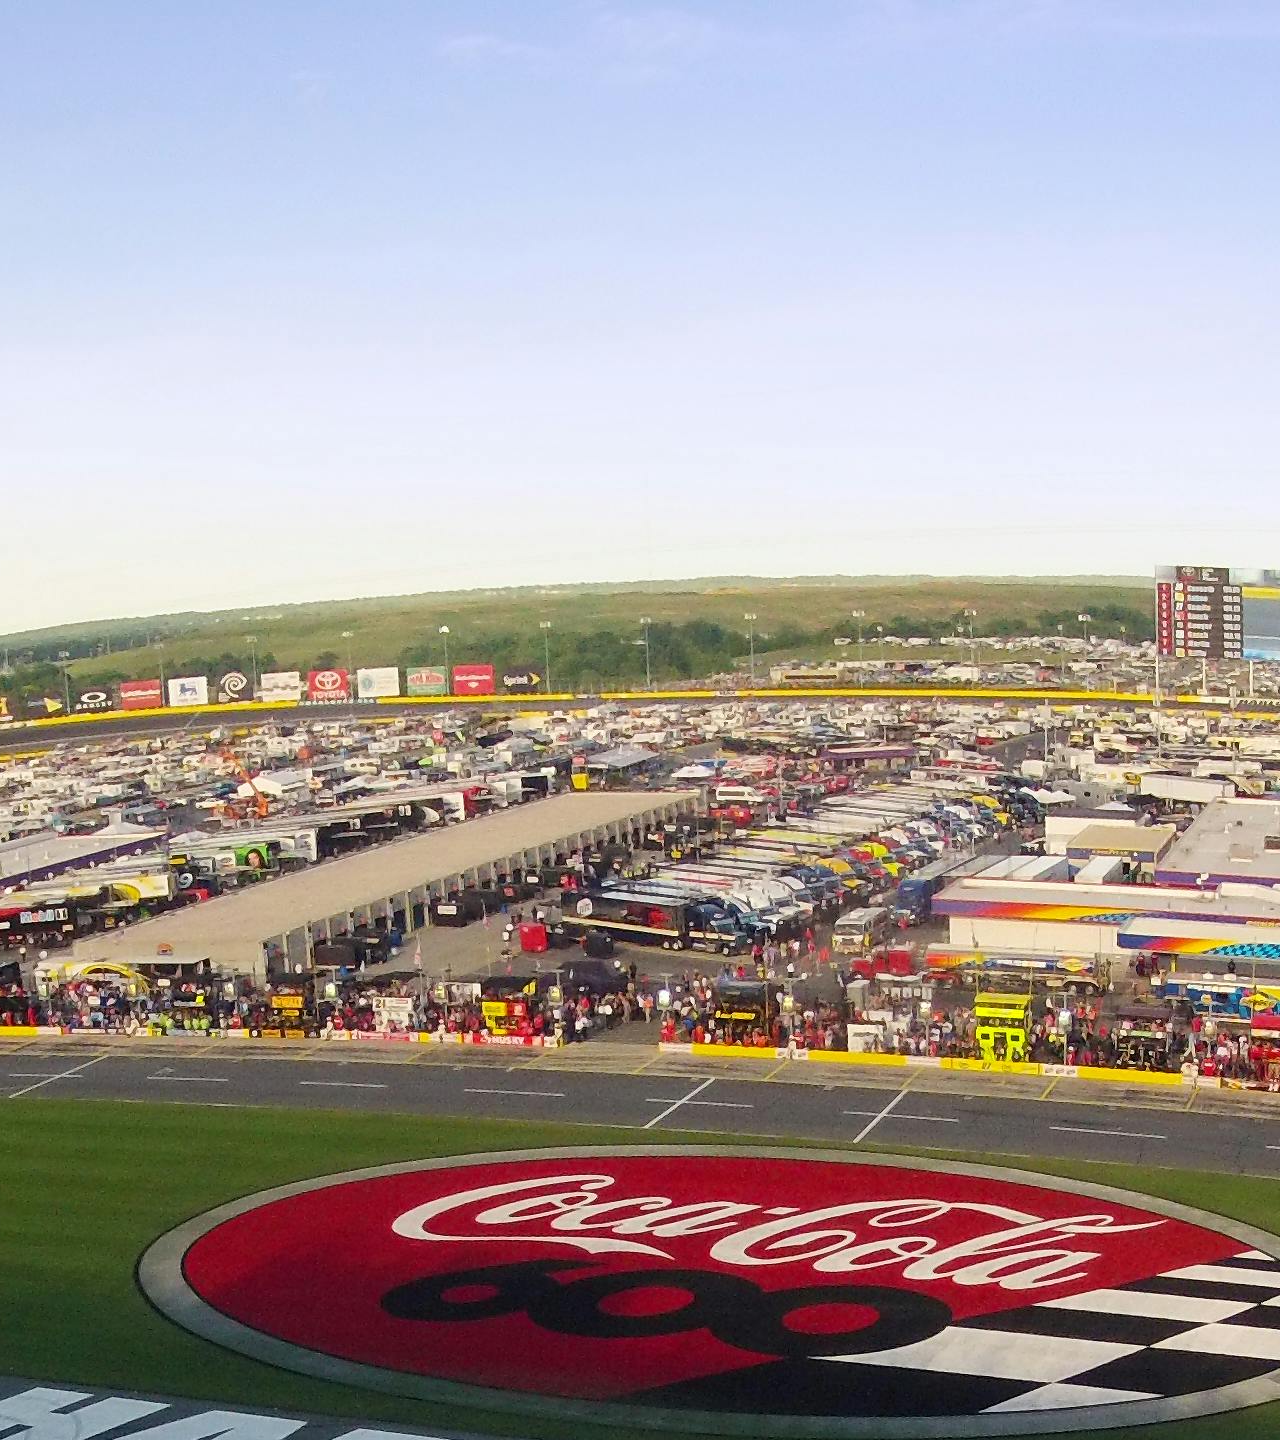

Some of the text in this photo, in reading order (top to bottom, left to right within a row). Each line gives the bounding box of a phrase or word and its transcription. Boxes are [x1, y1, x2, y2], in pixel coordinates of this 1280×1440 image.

[312, 691, 346, 700] TOYOTA
[21, 909, 55, 923] Mobil
[391, 1173, 1167, 1291] Coca-Cola
[381, 1258, 954, 1357] 600
